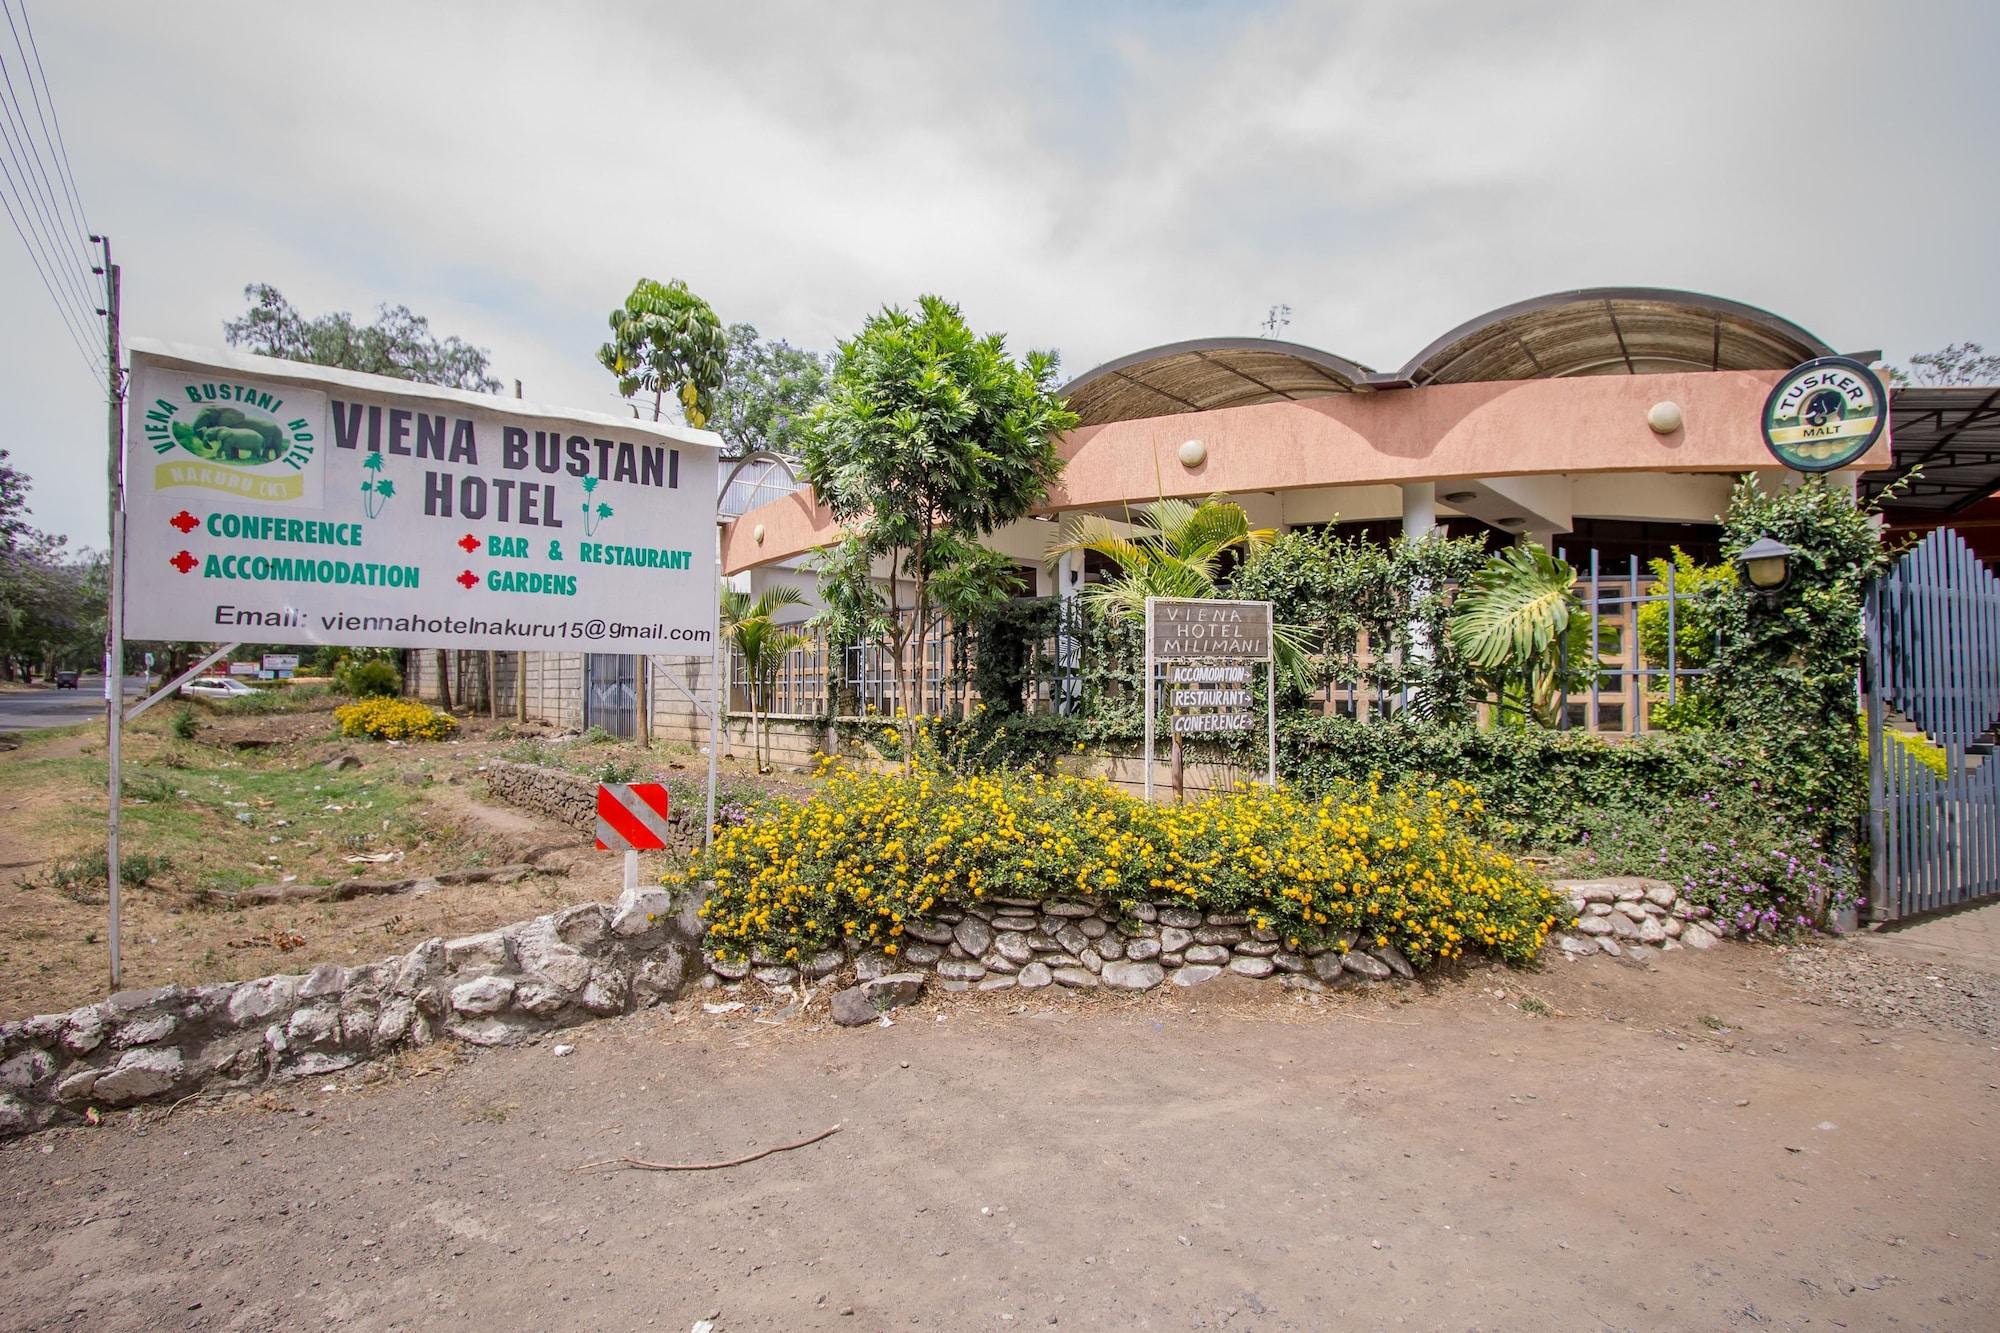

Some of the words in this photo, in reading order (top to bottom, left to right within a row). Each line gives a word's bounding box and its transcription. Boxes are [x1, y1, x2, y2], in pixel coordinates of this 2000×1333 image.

[1780, 373, 1864, 411] TUSKER
[144, 398, 179, 455] VIENA
[184, 382, 284, 414] BUSTANI
[282, 417, 315, 471] HOTEL
[1803, 425, 1841, 438] MALT
[331, 400, 478, 465] VIENA
[502, 425, 680, 489] BUSTANI
[424, 470, 563, 528] HOTEL
[207, 512, 363, 546] CONFERENCE
[488, 535, 529, 559] BAR
[548, 539, 563, 561] &
[580, 542, 692, 570] RESTAURANT
[204, 554, 420, 588] ACCOMMODATION
[487, 569, 577, 596] GARDENS
[215, 605, 307, 628] Email:
[321, 612, 711, 642] viennahotelnakuru15@gmail.com
[1166, 607, 1242, 622] VIENA
[1164, 639, 1260, 653] MILIMANI
[1177, 624, 1243, 639] HOTEL
[1174, 666, 1245, 682] ACCOMODATION
[1175, 689, 1245, 706] RESTAURANT
[1174, 714, 1247, 732] CONFERENCE
